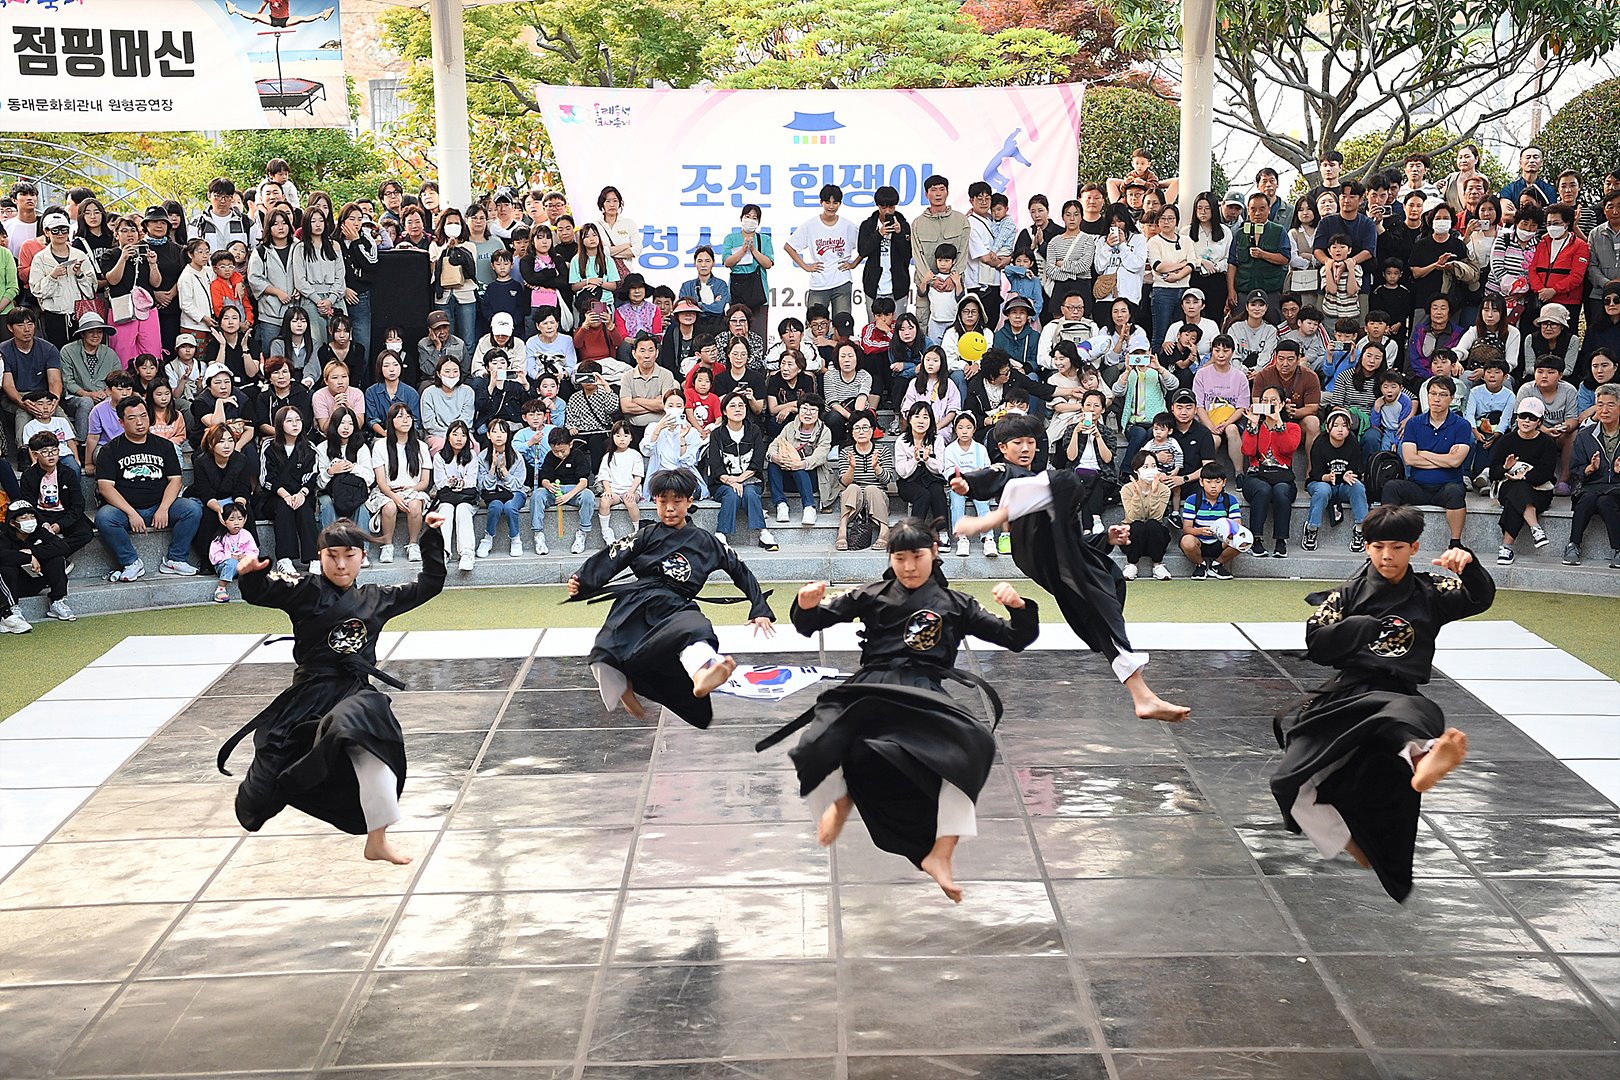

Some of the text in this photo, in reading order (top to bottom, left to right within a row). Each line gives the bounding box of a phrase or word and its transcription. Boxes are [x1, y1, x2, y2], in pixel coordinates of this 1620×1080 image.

[12, 25, 195, 77] 점핑머신
[7, 98, 173, 112] 동래문화회관내 원형공연장
[680, 164, 771, 207] 조선
[118, 453, 164, 469] YOSEMITE
